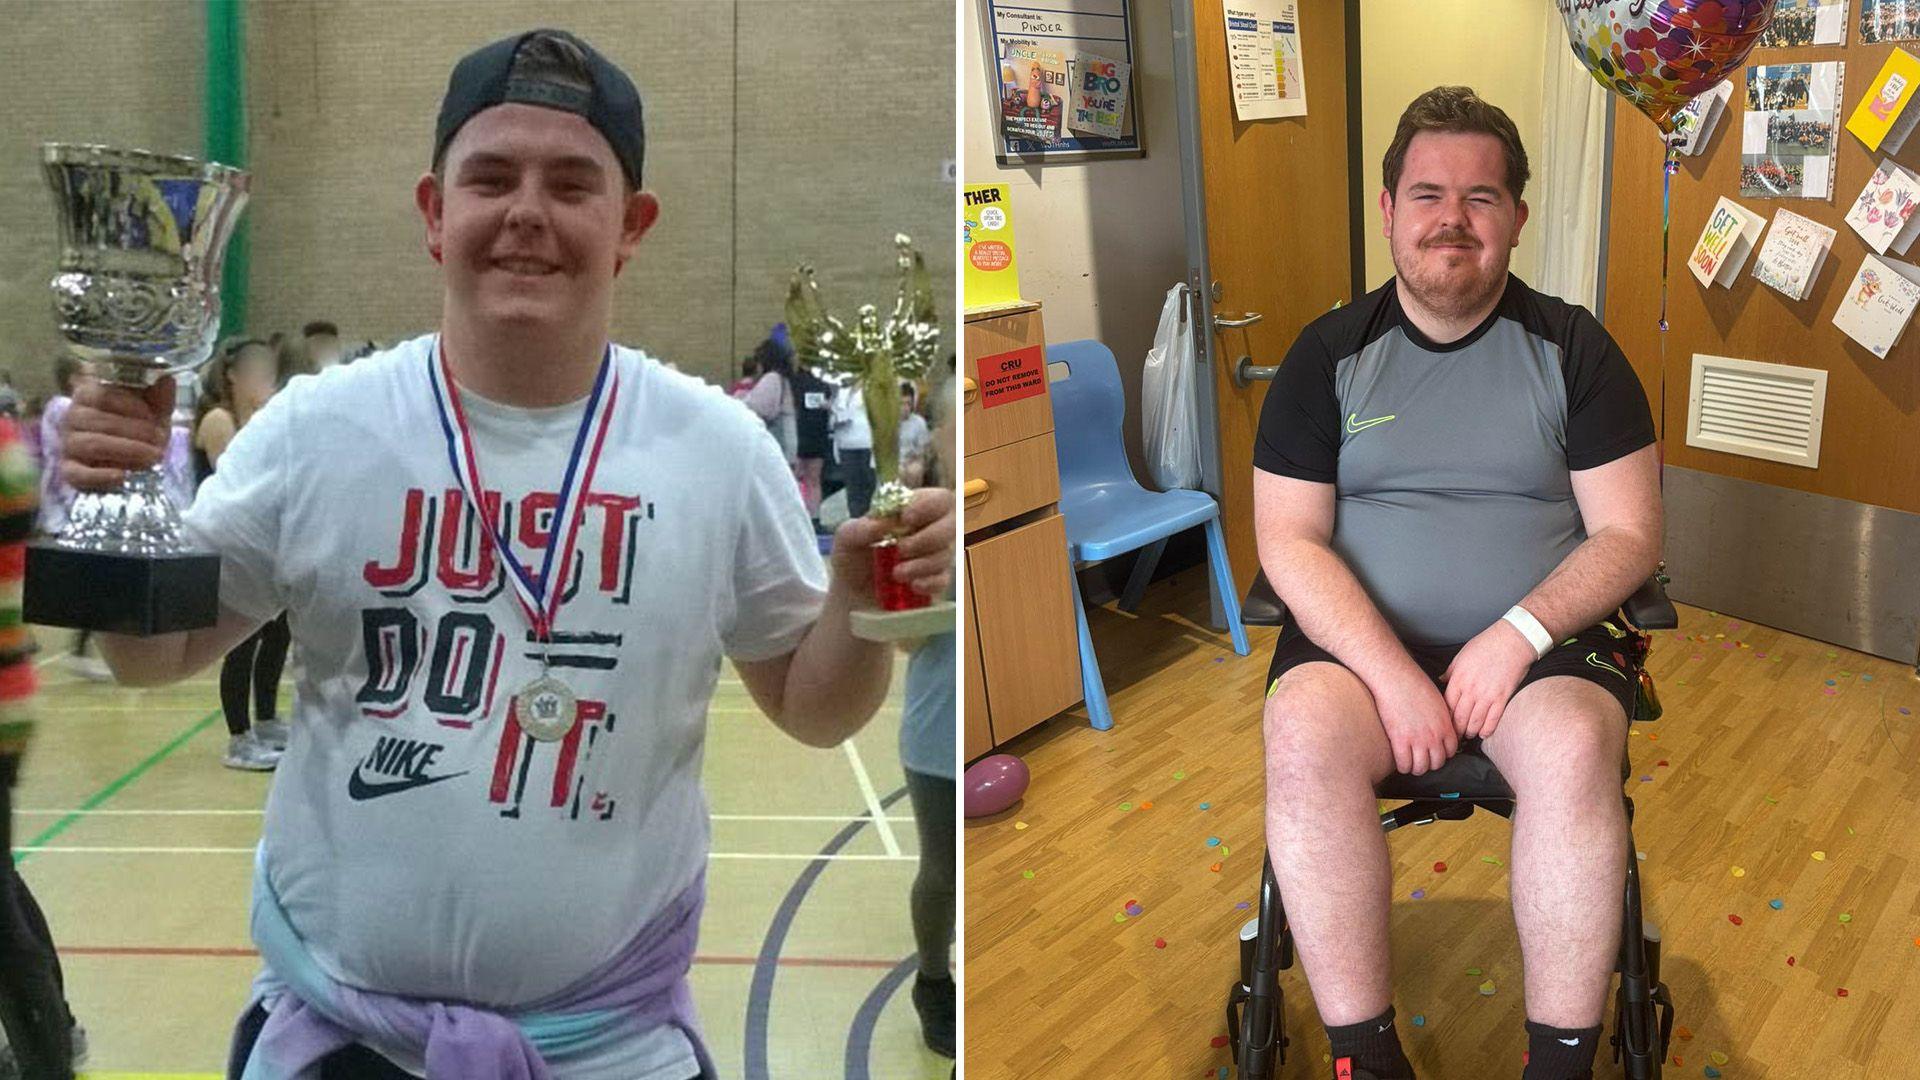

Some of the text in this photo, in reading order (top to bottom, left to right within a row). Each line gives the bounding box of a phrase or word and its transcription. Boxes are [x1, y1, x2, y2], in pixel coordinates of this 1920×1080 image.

[997, 11, 1005, 19] My
[1006, 12, 1035, 20] Consultant
[1009, 39, 1030, 47] Mobility
[1084, 72, 1120, 95] BRO
[1083, 96, 1116, 112] YOU'RE
[1076, 109, 1093, 122] THE
[964, 188, 1001, 206] THER
[1713, 208, 1738, 238] GET
[1703, 225, 1728, 260] WELL
[1694, 245, 1717, 276] SOON
[1001, 359, 1022, 371] CRU
[997, 376, 1010, 384] NOT
[1012, 369, 1039, 380] REMOVE
[986, 378, 1042, 397] FROM THIS WARD
[362, 488, 655, 605] JUST
[355, 606, 506, 731] DO
[364, 736, 445, 782] NIKE
